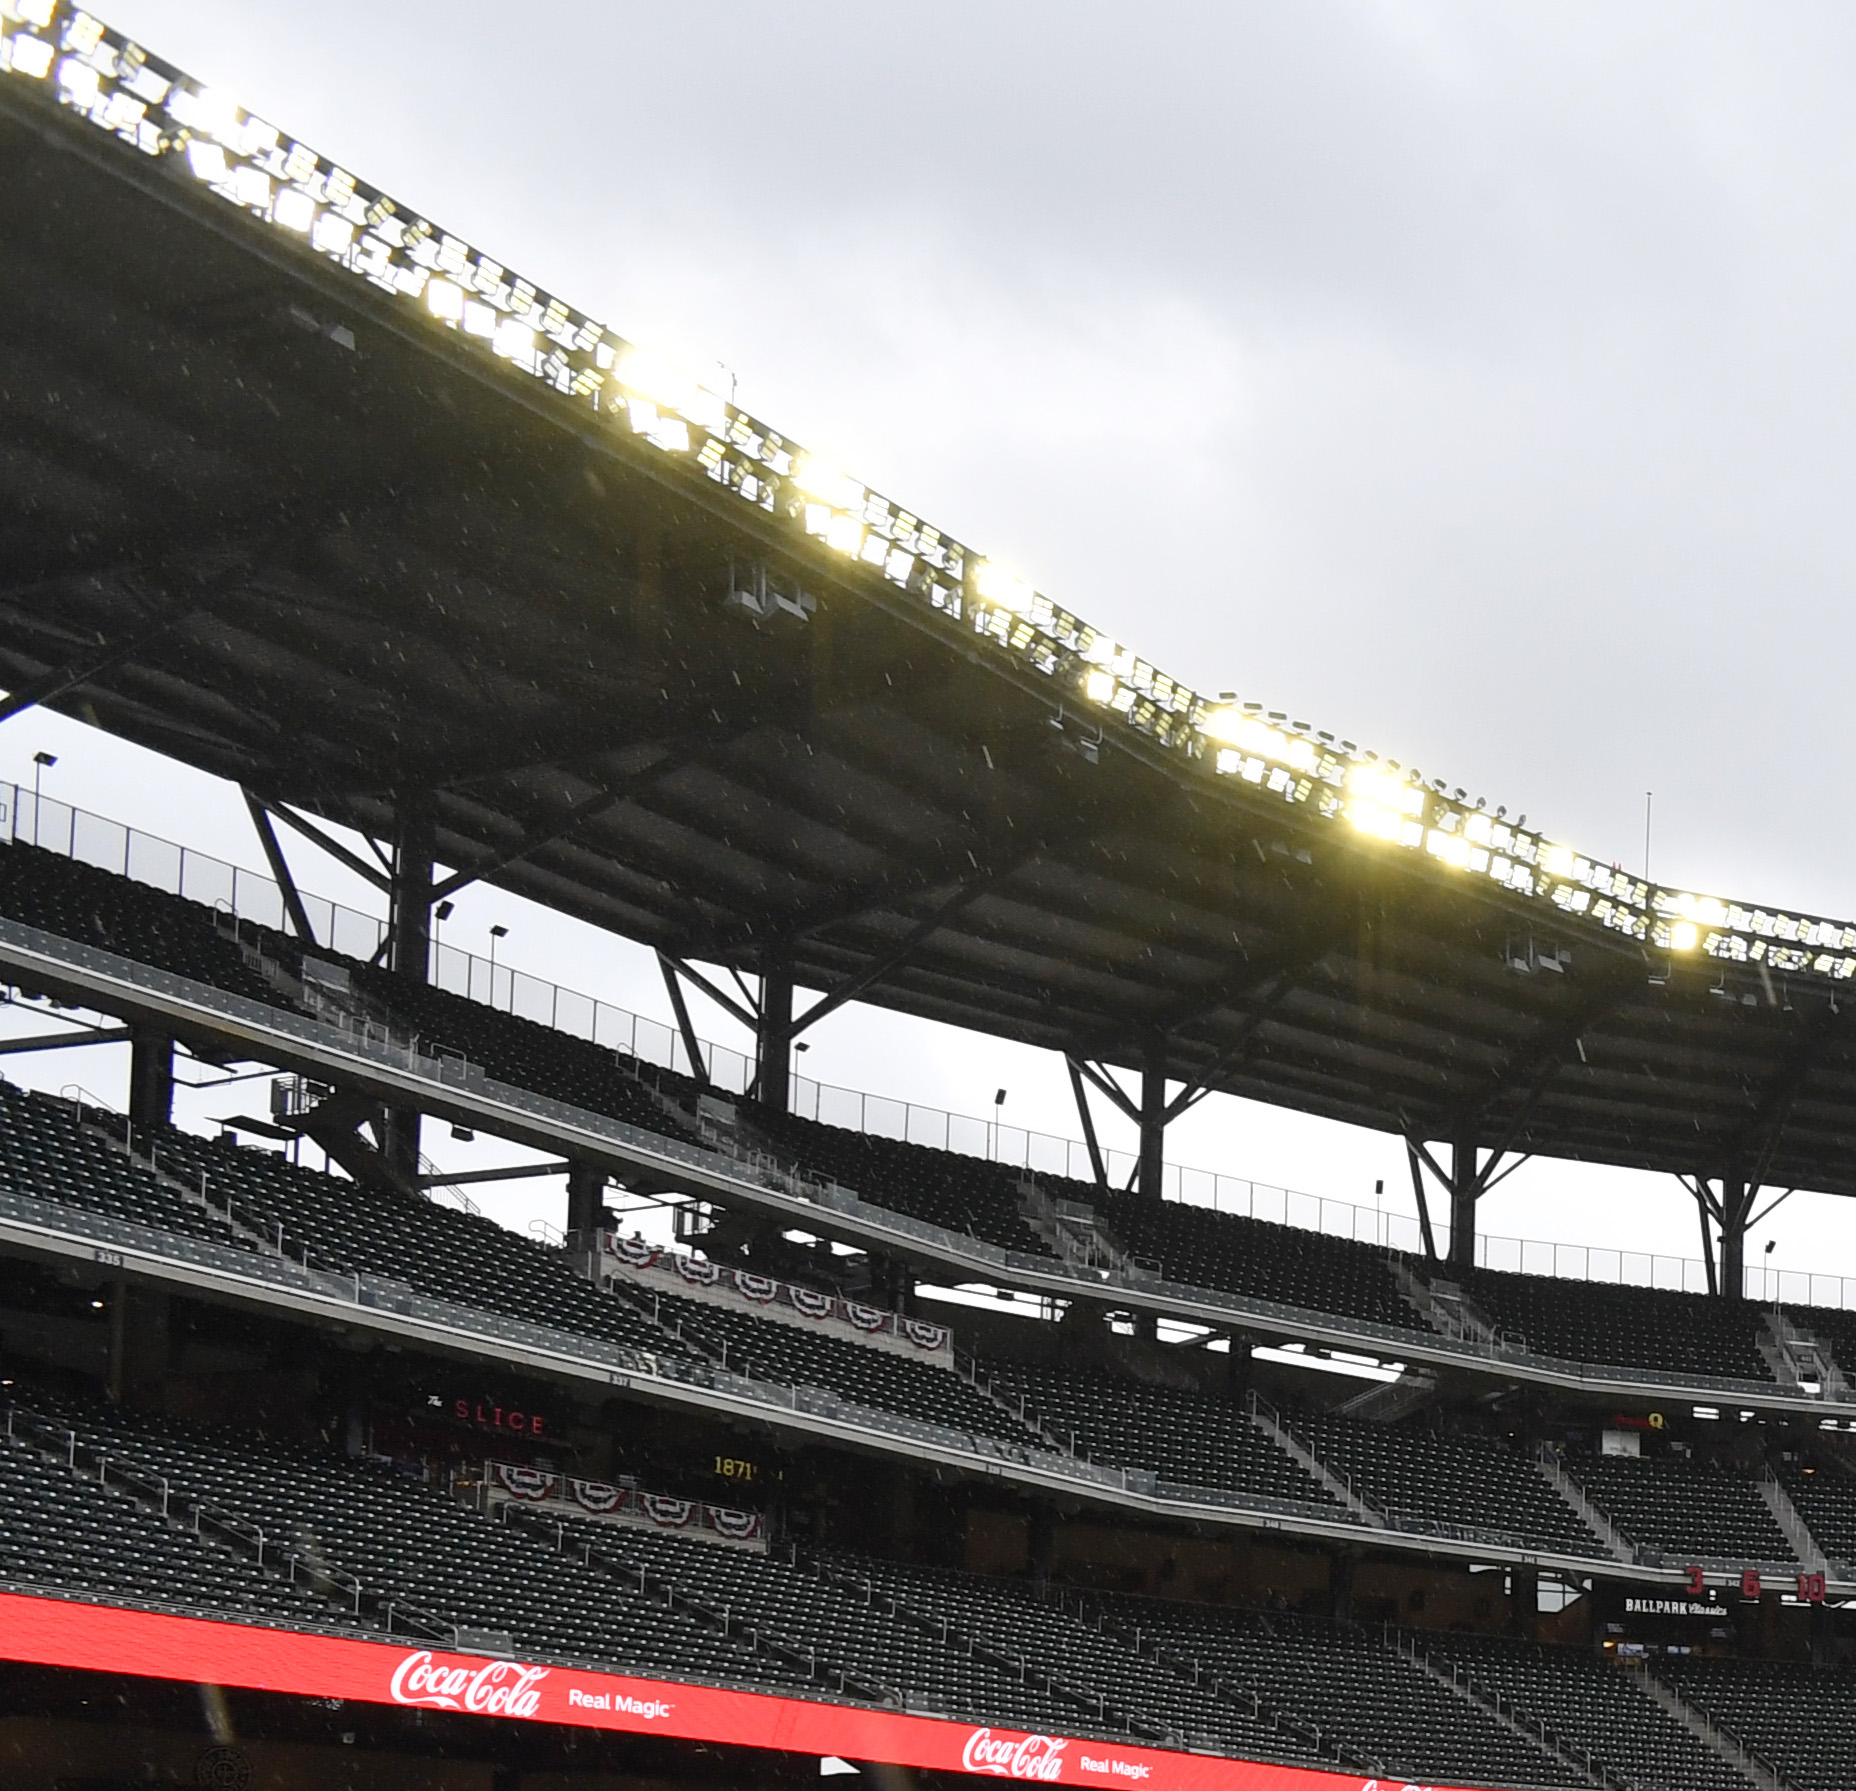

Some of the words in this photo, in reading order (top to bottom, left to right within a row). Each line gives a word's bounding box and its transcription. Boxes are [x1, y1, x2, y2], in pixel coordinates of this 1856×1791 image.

[455, 1400, 543, 1434] SLICE
[714, 1455, 752, 1481] 1871
[1685, 1566, 1703, 1594] 3
[1742, 1569, 1760, 1598] 6
[1797, 1574, 1826, 1601] 10
[1625, 1598, 1688, 1616] BALLPARK
[390, 1650, 550, 1717] Coca-Cola
[568, 1688, 610, 1710] Real
[615, 1694, 671, 1719] Magic
[962, 1727, 1069, 1782] Coca-Cola
[1080, 1756, 1110, 1774] Real
[1112, 1759, 1150, 1779] Magic
